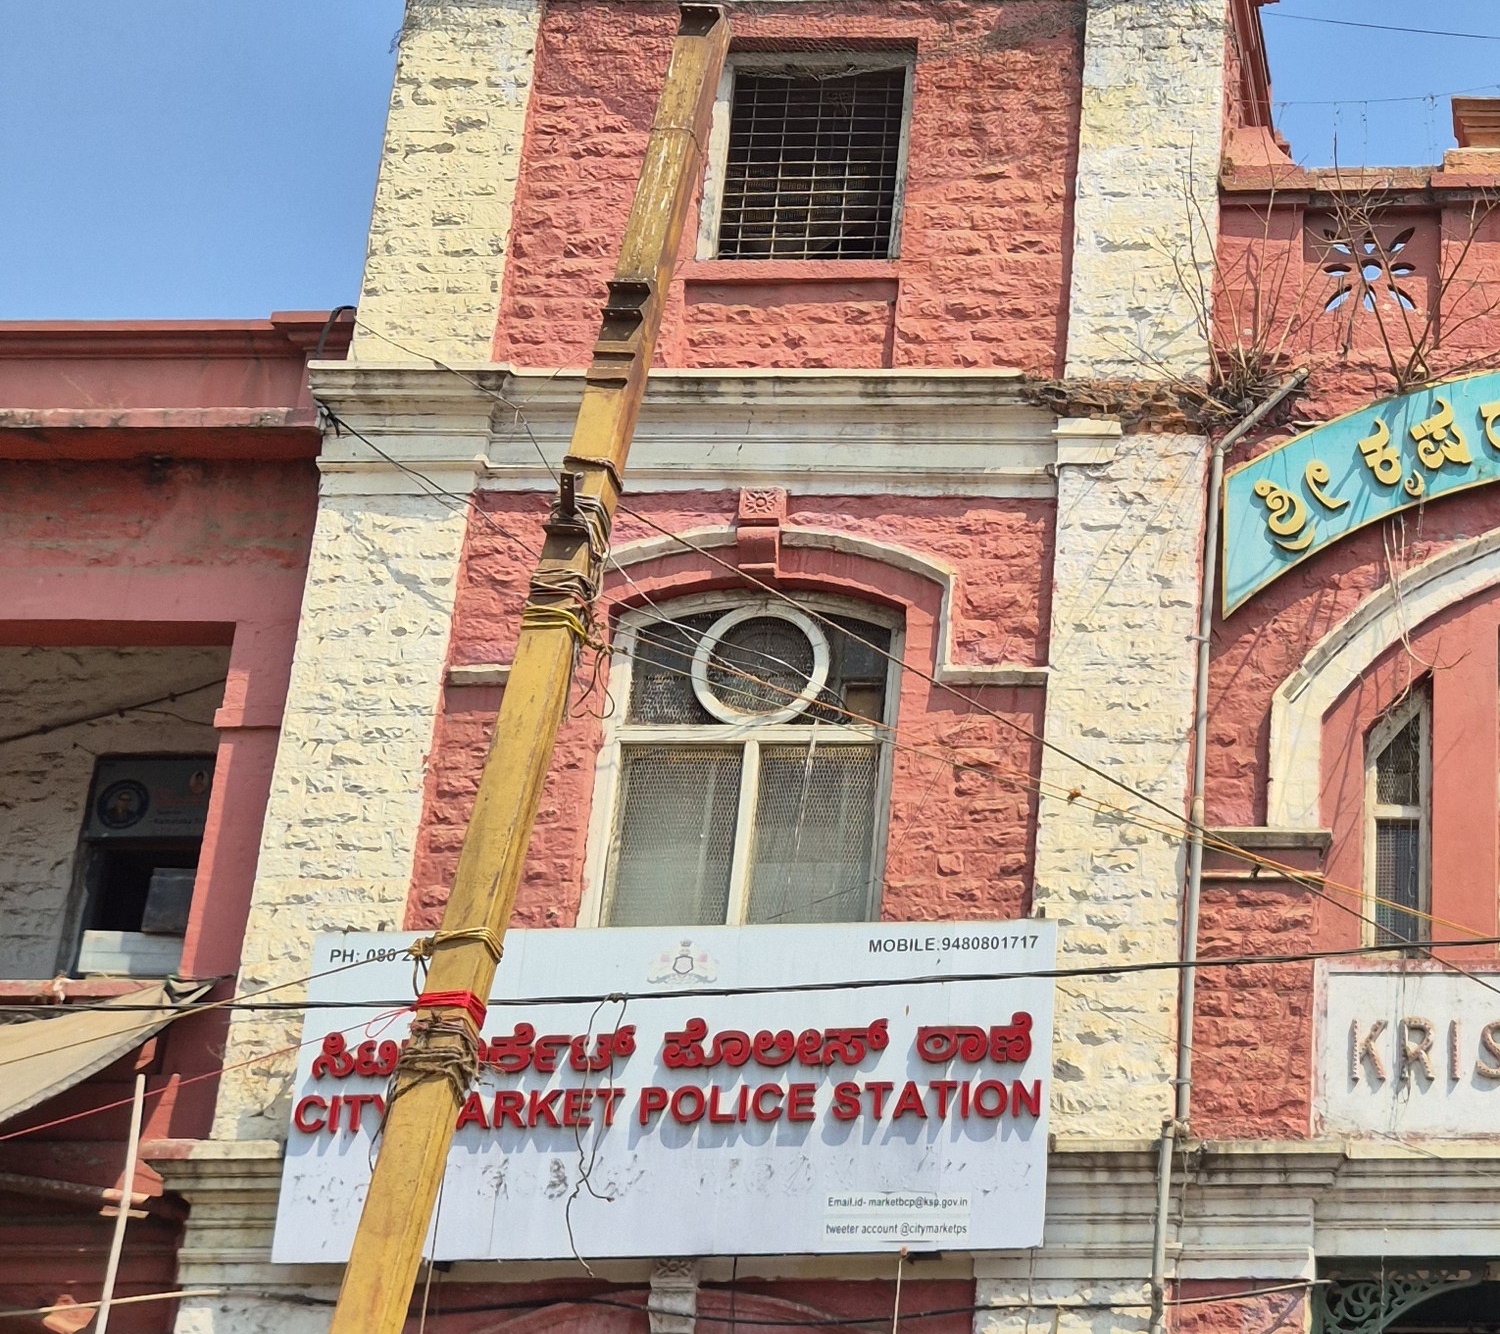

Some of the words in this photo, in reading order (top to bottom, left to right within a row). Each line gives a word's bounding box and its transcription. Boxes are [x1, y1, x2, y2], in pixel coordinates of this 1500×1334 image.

[1254, 459, 1350, 550] ಶ್ರೀ
[329, 948, 360, 963] PH:
[366, 948, 397, 963] 080
[662, 1016, 890, 1068] ಪೊಲೀಸ್
[916, 1010, 1034, 1064] ಠಾಣೆ
[455, 1086, 627, 1130] ARKET
[638, 1082, 818, 1126] POLICE
[832, 1078, 1042, 1122] STATION
[868, 1196, 968, 1209] marketbcp@ksp.gov.in
[825, 1224, 859, 1234] tweeter
[861, 1224, 898, 1235] account
[899, 1222, 968, 1236] @citymarketps
